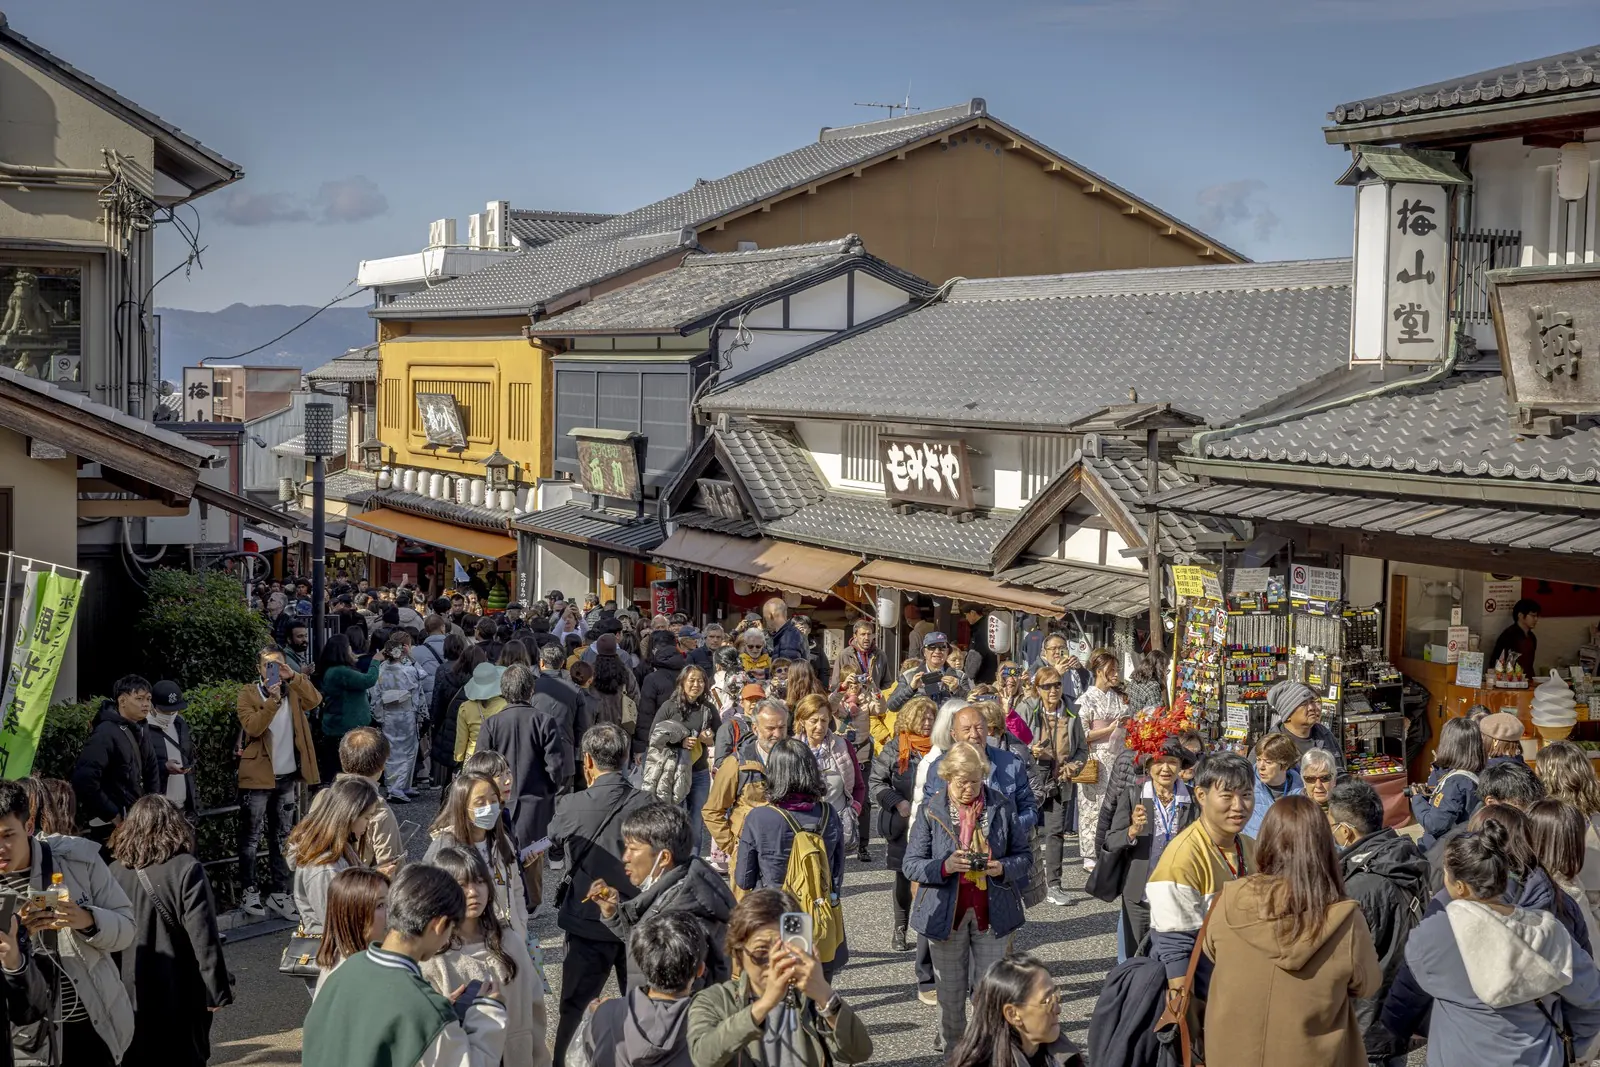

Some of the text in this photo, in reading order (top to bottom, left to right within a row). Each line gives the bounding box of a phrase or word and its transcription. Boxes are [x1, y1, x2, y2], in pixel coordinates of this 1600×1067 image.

[1393, 198, 1438, 345] 梅山堂
[38, 594, 75, 680] ボランティア
